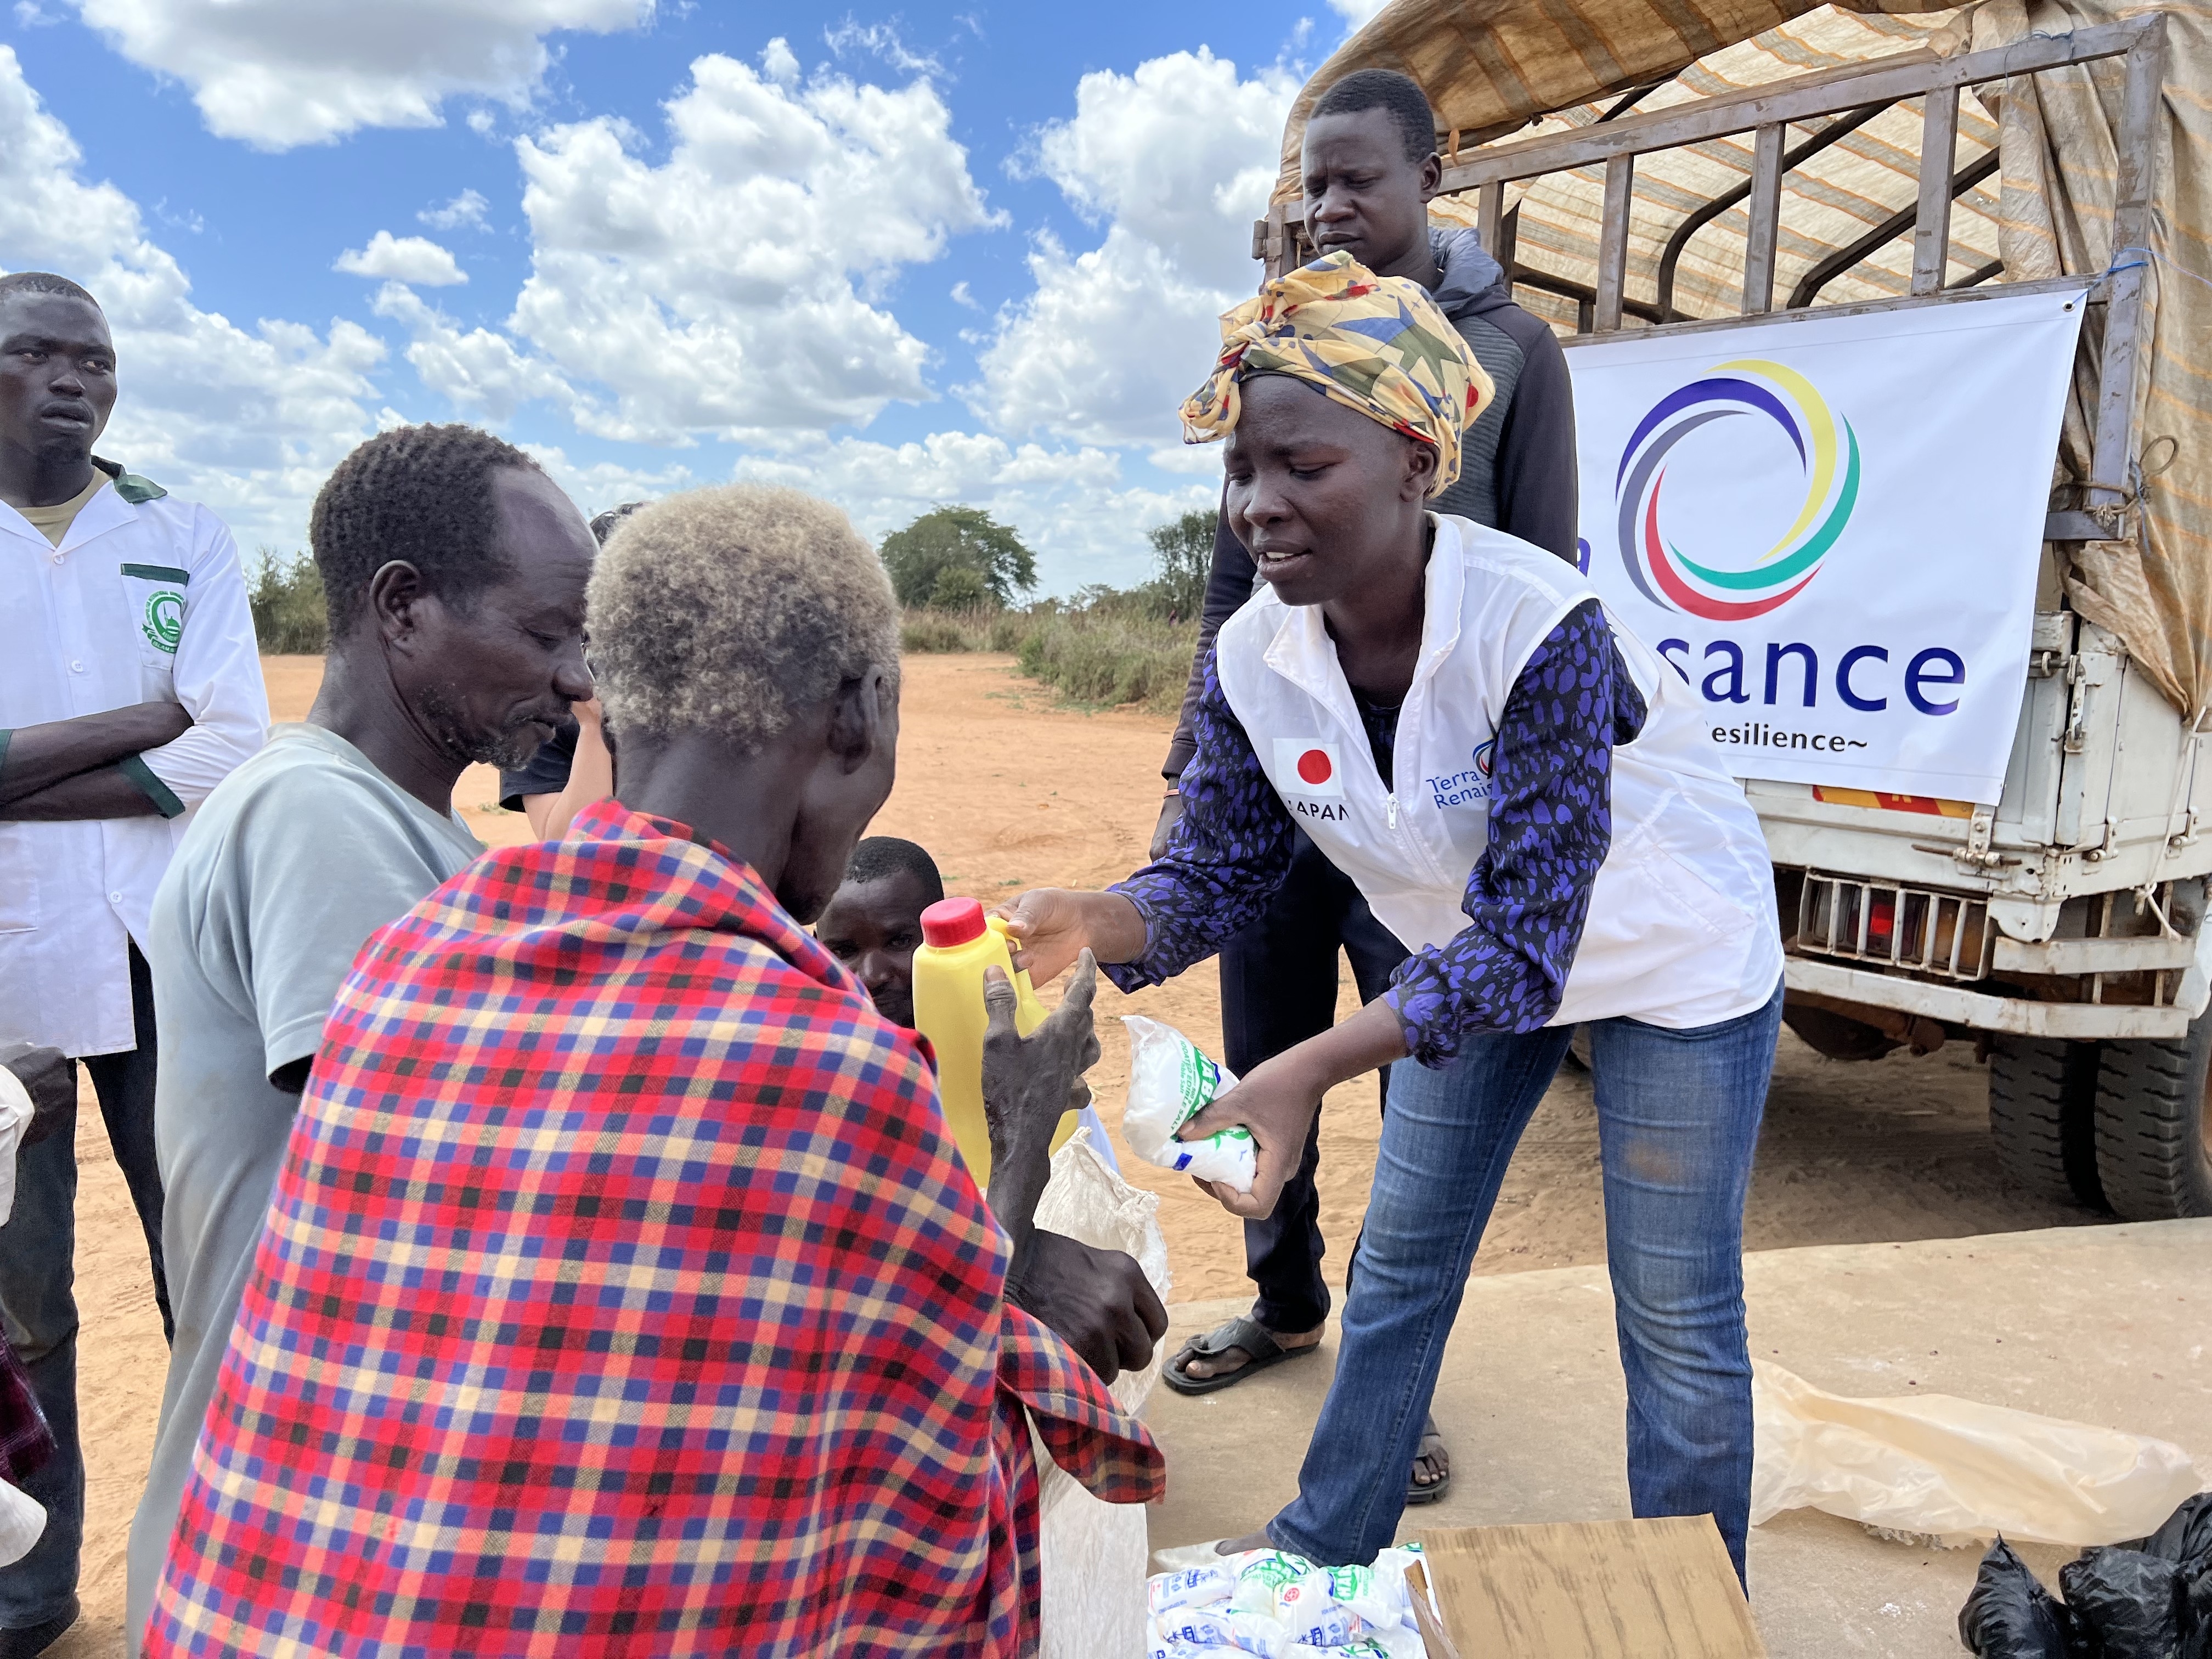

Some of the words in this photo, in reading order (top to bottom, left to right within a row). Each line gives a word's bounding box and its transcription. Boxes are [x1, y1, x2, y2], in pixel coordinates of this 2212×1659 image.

[1706, 721, 1868, 752] esilience~
[1425, 771, 1480, 793] Terra
[1181, 1075, 1193, 1108] EDIBLE
[1171, 1108, 1184, 1131] SALT
